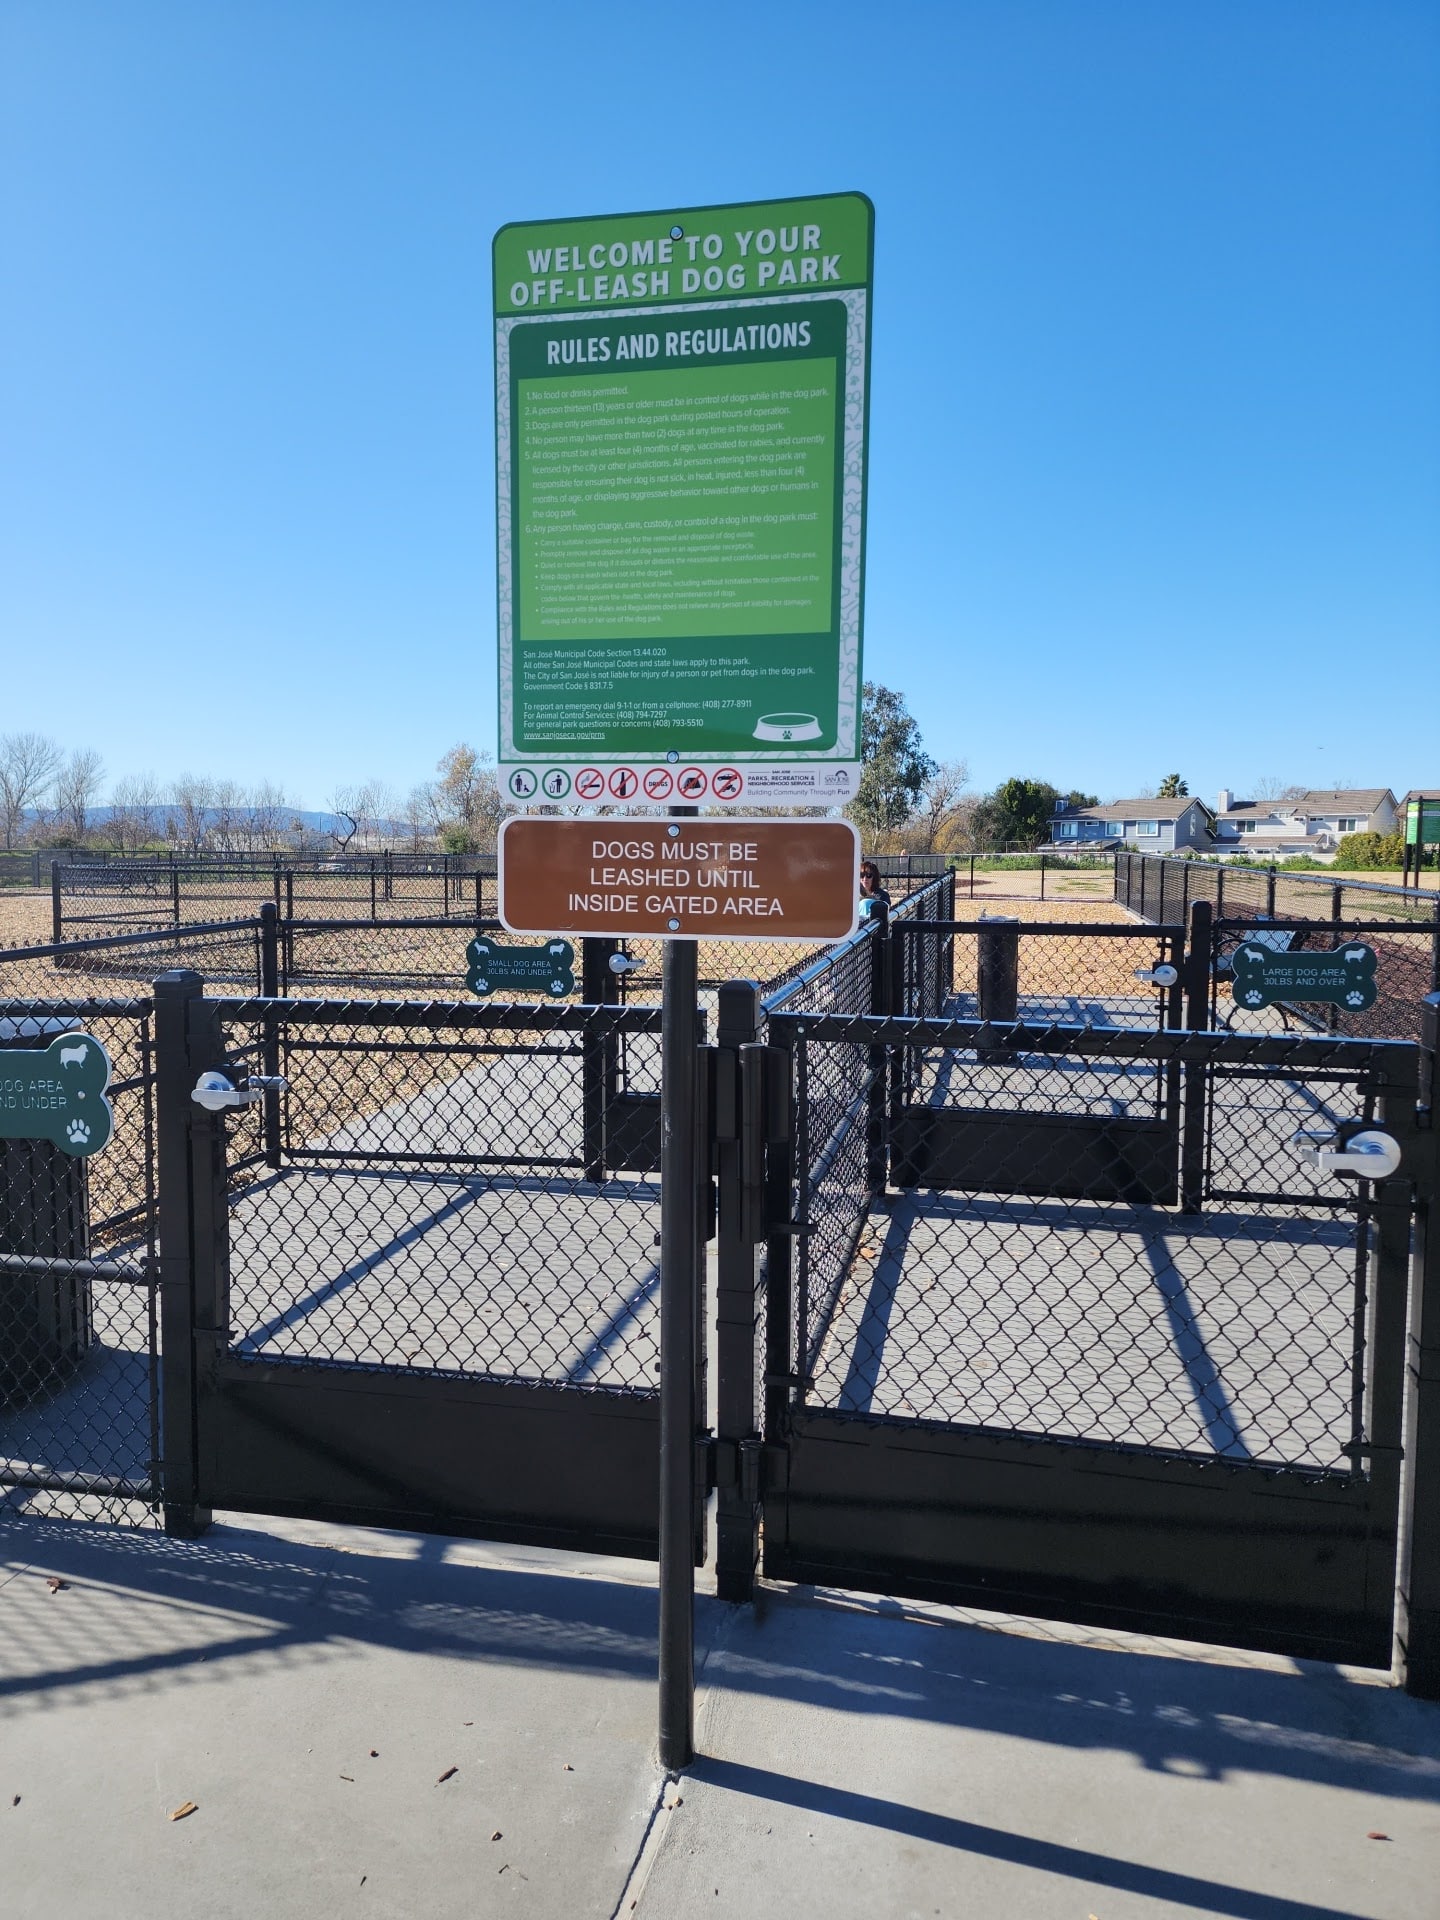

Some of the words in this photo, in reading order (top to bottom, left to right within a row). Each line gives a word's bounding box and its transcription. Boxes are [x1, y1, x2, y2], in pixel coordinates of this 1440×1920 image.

[527, 238, 674, 274] WELCOME
[685, 234, 723, 261] TO
[735, 224, 821, 257] YOUR
[510, 271, 670, 306] OFF-LEASH
[682, 264, 745, 293] DOG
[758, 255, 842, 286] PARK
[547, 336, 611, 365] RULES
[616, 333, 659, 359] AND
[666, 321, 811, 356] REGULATIONS
[543, 391, 559, 400] food
[570, 389, 591, 398] drinks
[592, 387, 628, 398] permitted.
[538, 407, 563, 416] person
[563, 404, 591, 413] thirteen
[592, 403, 604, 413] (13)
[606, 403, 625, 412] years
[635, 400, 654, 408] older
[655, 398, 673, 407] must
[674, 398, 684, 406] be
[685, 397, 692, 405] in
[693, 396, 719, 405] control
[720, 395, 728, 403] of
[729, 394, 748, 404] dogs
[749, 392, 769, 401] while
[779, 391, 792, 399] the
[793, 390, 808, 400] dog
[810, 389, 828, 399] park.
[564, 419, 579, 430] only
[580, 417, 615, 429] permitted
[616, 417, 623, 425] in
[624, 416, 636, 424] the
[637, 415, 652, 425] dog
[652, 414, 669, 424] park
[670, 412, 694, 423] during
[695, 411, 720, 422] posted
[721, 410, 743, 418] hours
[744, 409, 752, 417] of
[753, 407, 790, 418] operation.
[553, 650, 585, 660] Municipal
[606, 649, 631, 657] Section
[633, 648, 666, 657] 13.44.020
[583, 660, 615, 670] Municipal
[689, 658, 708, 668] apply
[732, 657, 750, 667] park.
[537, 672, 550, 681] City
[641, 670, 660, 680] injury
[676, 671, 699, 679] person
[710, 669, 721, 678] pet
[740, 668, 758, 678] dogs
[781, 668, 795, 677] dog
[797, 667, 814, 677] park.
[584, 682, 587, 690] §
[533, 702, 553, 712] report
[565, 704, 601, 712] emergency
[665, 701, 700, 710] cellphone:
[702, 700, 720, 710] (408)
[616, 711, 634, 719] (408)
[535, 720, 561, 730] general
[562, 720, 577, 729] park
[578, 719, 610, 729] questions
[652, 719, 670, 728] (408)
[524, 731, 606, 740] www.sanjoseca.gov/prns
[592, 842, 654, 859] DOGS
[662, 843, 723, 860] MUST
[730, 843, 758, 861] BE
[591, 868, 690, 886] LEASHED
[698, 870, 760, 888] UNTIL
[569, 894, 639, 912] INSIDE
[646, 895, 718, 914] GATED
[723, 898, 784, 915] AREA
[29, 1080, 64, 1092] AREA
[22, 1097, 67, 1108] UNDER
